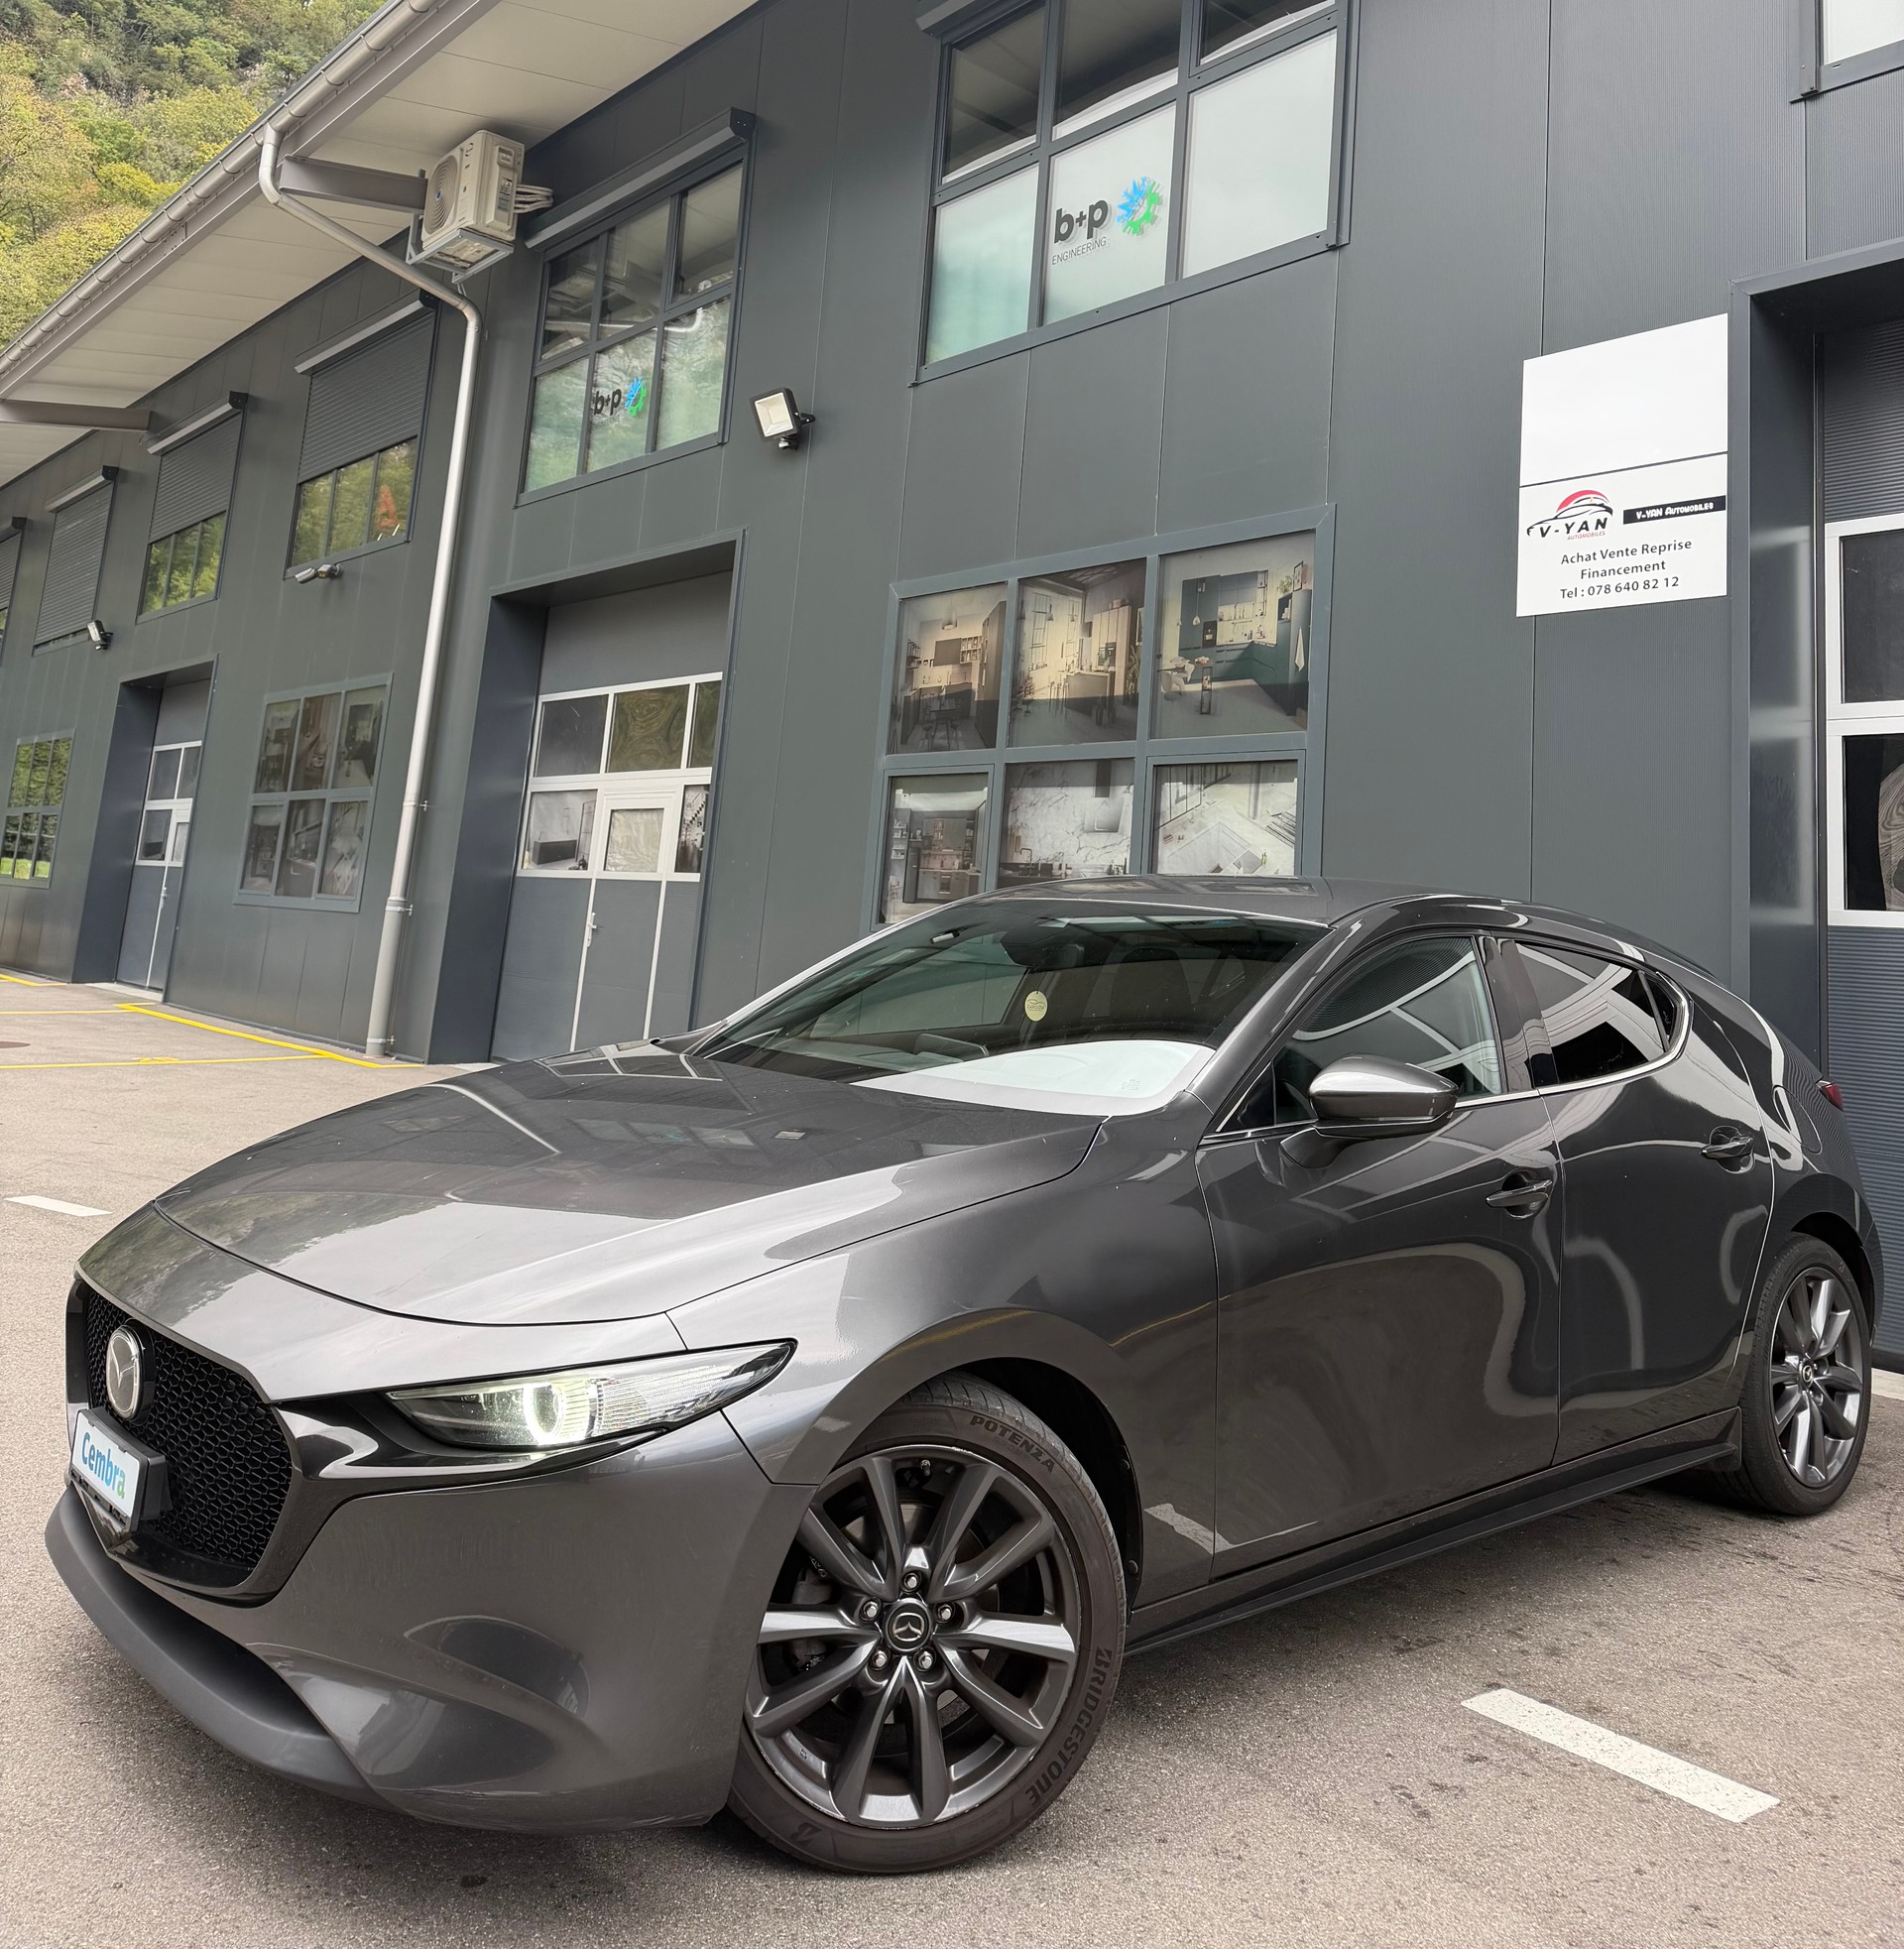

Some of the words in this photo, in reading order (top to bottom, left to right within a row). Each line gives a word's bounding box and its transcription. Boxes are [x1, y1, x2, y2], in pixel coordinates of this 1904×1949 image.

[1053, 199, 1109, 244] b+p
[1051, 236, 1107, 266] ENGINEERING
[594, 388, 622, 416] b+p
[1635, 507, 1663, 520] V-YAN
[1539, 517, 1608, 539] V-YAN
[1566, 531, 1606, 541] AUTOMOBILES
[1560, 551, 1598, 565] Achat
[1601, 547, 1637, 559] Vente
[1641, 540, 1693, 555] Reprise
[1580, 559, 1667, 580] Financement
[1588, 583, 1611, 597] 078
[1614, 580, 1639, 593] 640
[1643, 578, 1659, 590] 82
[1664, 575, 1680, 588] 12
[969, 1414, 1056, 1474] POTENZA
[80, 1431, 126, 1500] Cembra
[1024, 1645, 1113, 1805] BRIDGESTONE
